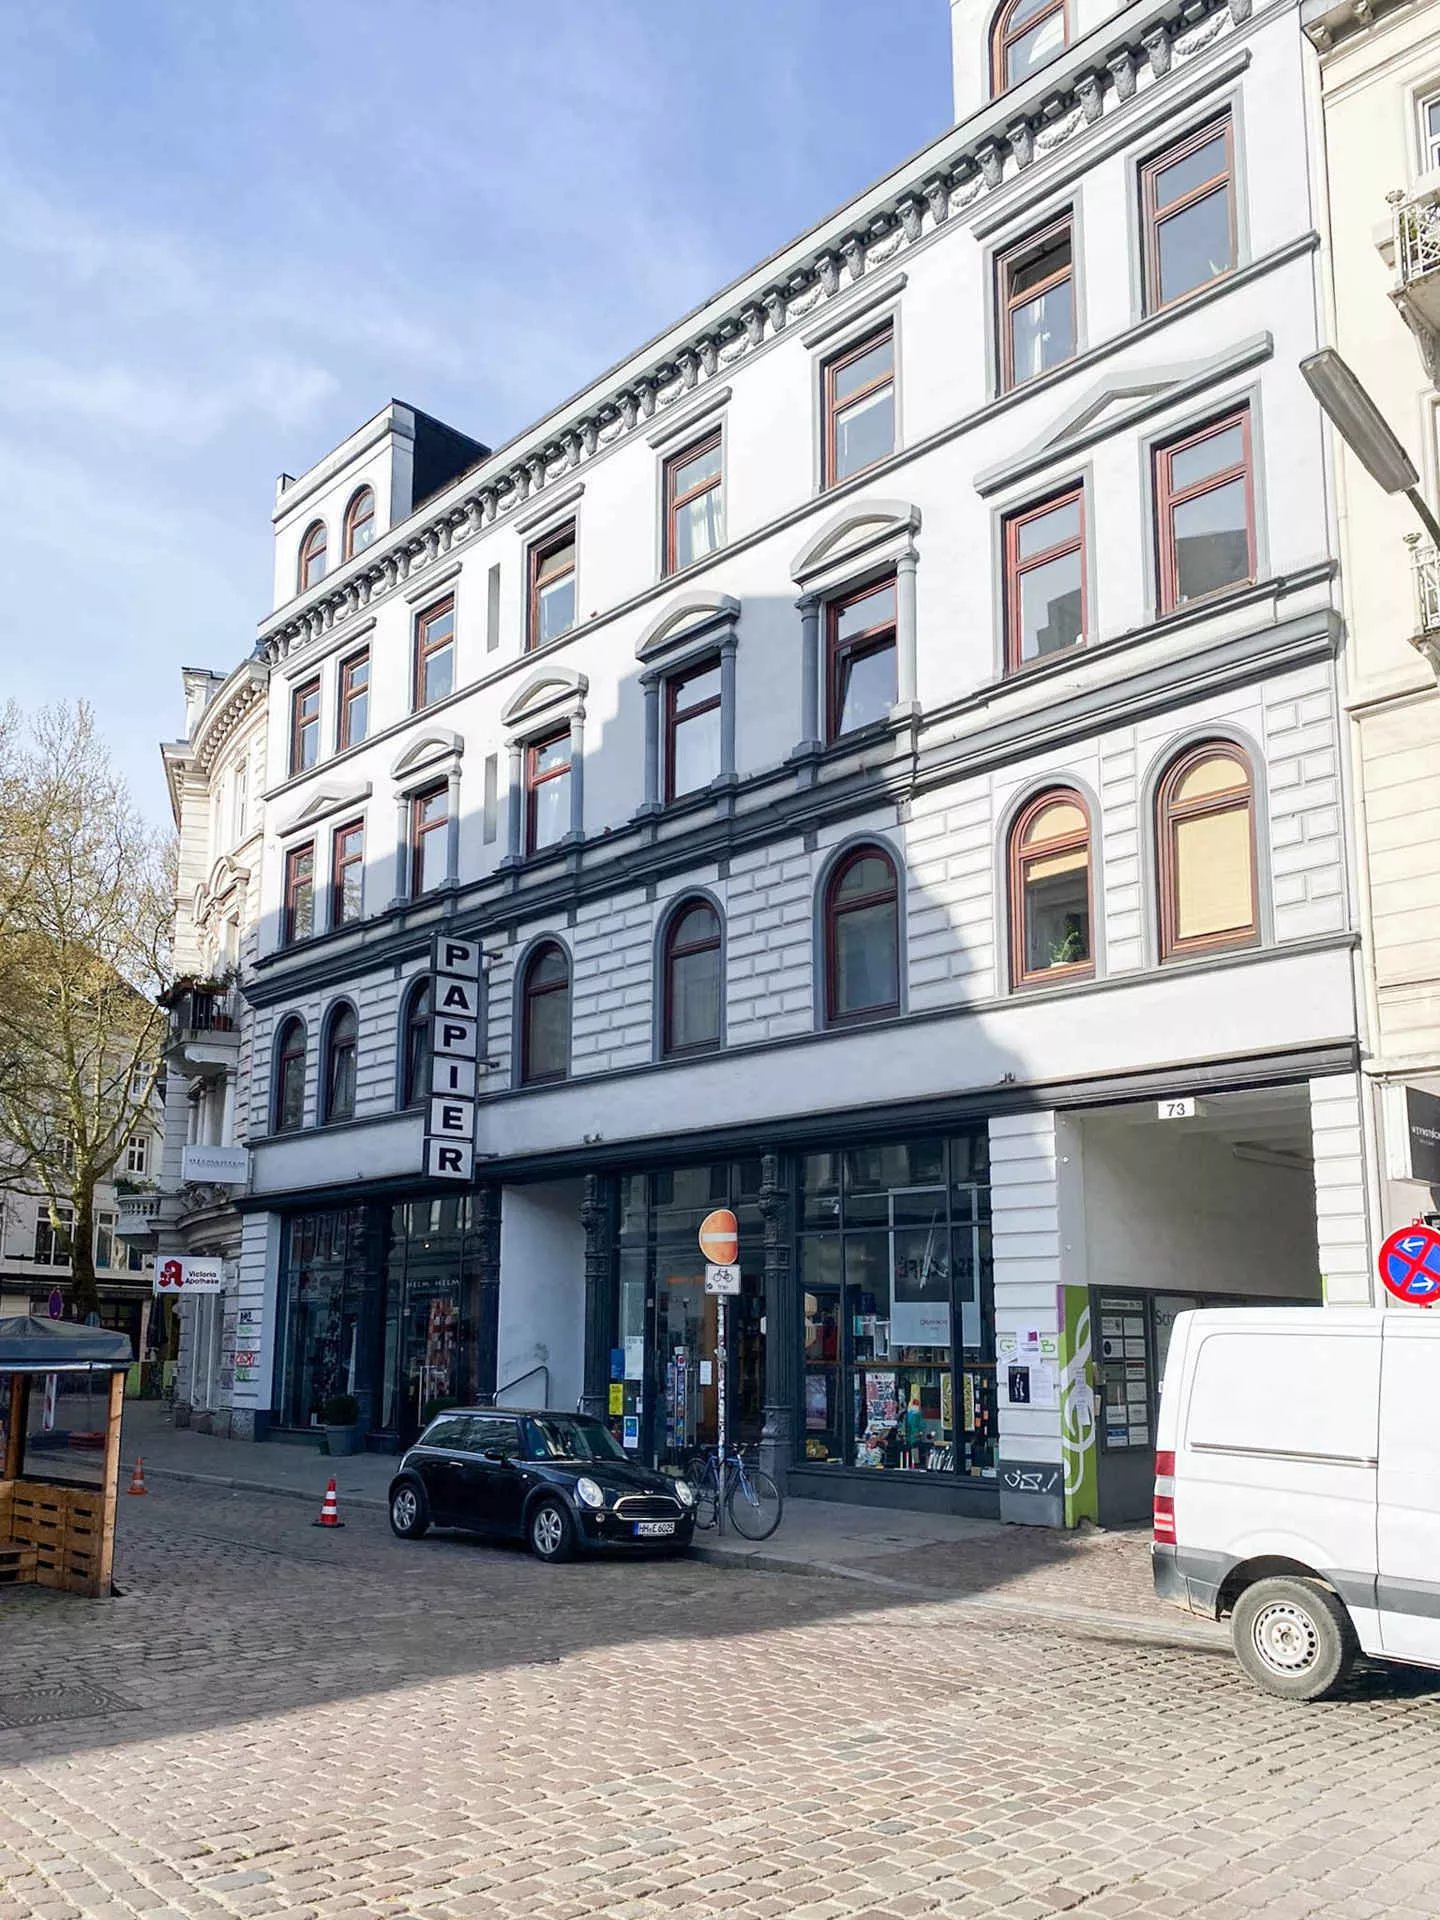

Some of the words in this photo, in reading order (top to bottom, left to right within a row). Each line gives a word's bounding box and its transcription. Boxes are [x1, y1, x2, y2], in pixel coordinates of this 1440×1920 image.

[438, 943, 470, 1173] PAPIER
[1166, 1102, 1185, 1117] 73
[188, 1270, 217, 1278] Victoria
[185, 1277, 219, 1285] Apotheke
